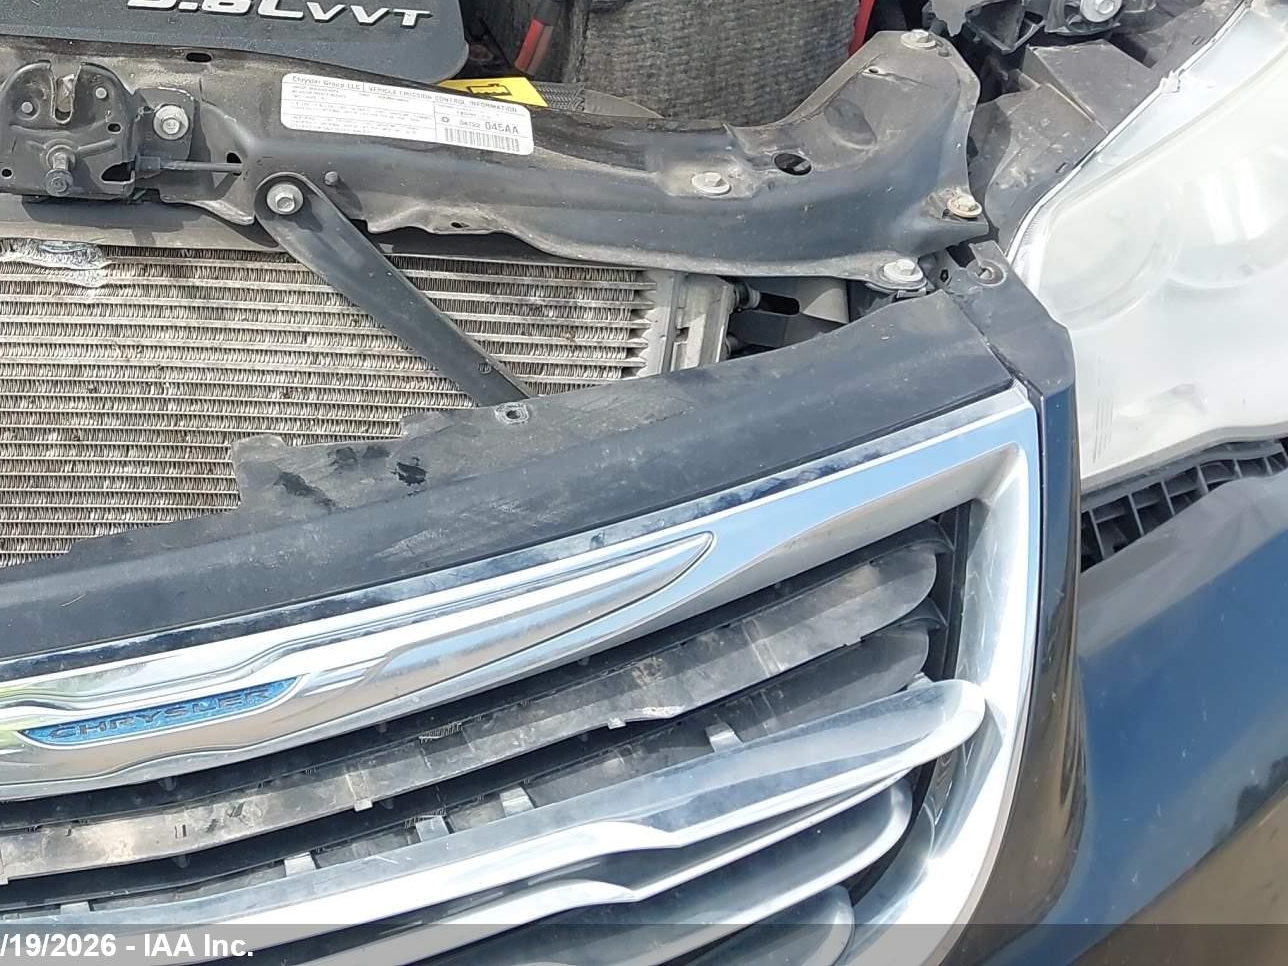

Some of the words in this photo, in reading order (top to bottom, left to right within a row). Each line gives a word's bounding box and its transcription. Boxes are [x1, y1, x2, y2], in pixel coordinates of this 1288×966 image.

[293, 76, 321, 85] Chrysler
[324, 80, 344, 88] Group
[369, 86, 396, 94] VEHICLE
[400, 91, 432, 100] EMISSION
[435, 96, 465, 105] CONTROL
[469, 101, 517, 113] INFORMATION
[49, 688, 270, 739] CHRYSLER
